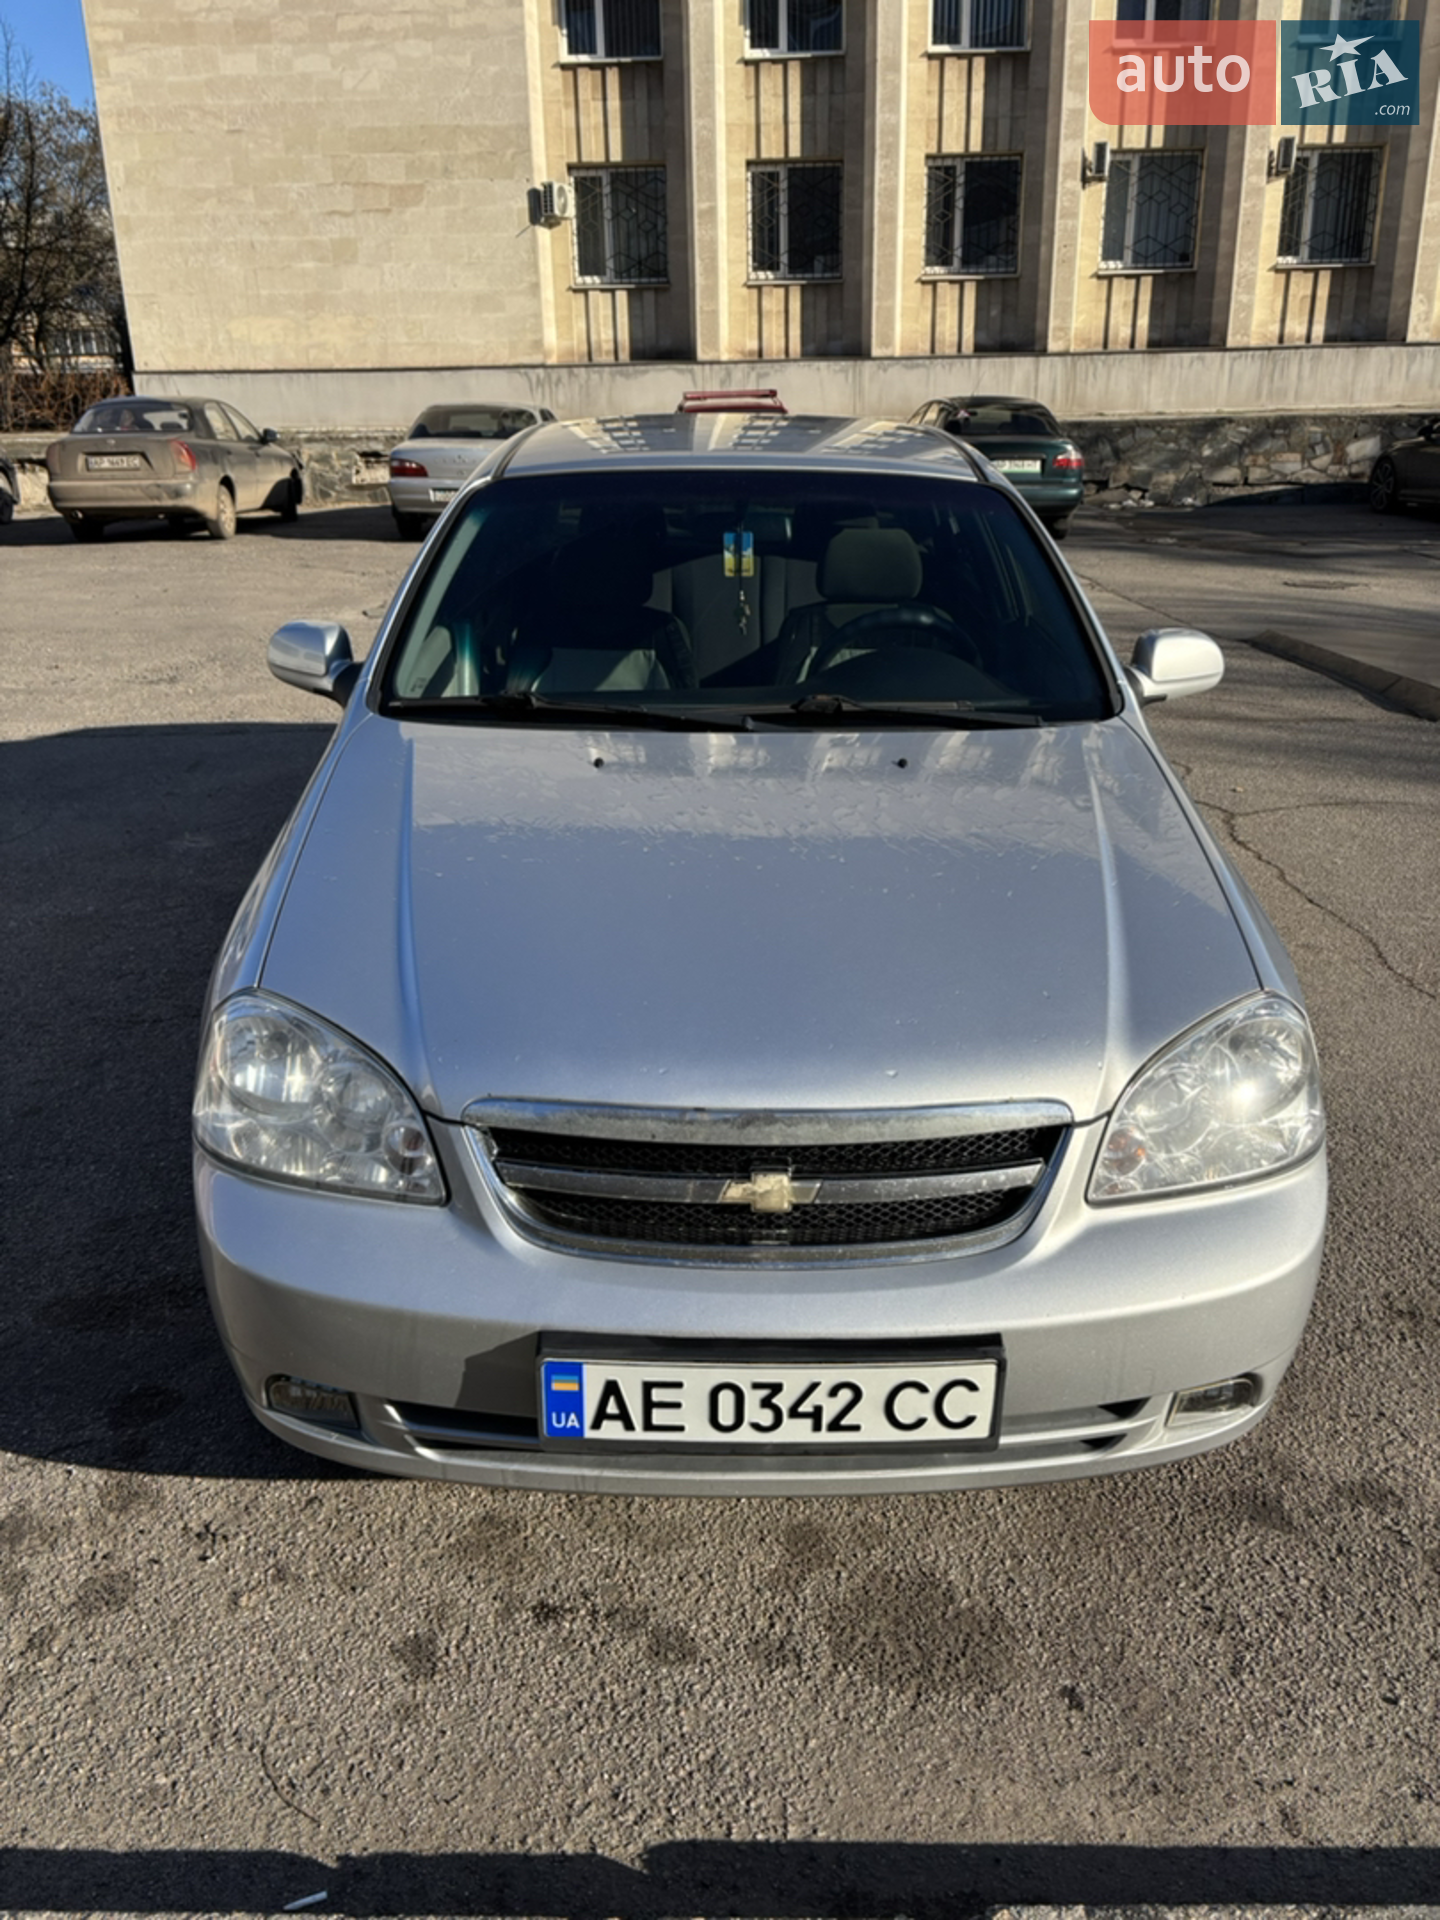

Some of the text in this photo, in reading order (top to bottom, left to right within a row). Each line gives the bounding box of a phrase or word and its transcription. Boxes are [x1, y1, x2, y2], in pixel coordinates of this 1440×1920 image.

[552, 1413, 580, 1429] UA
[590, 1378, 980, 1433] AE 0342 CC
